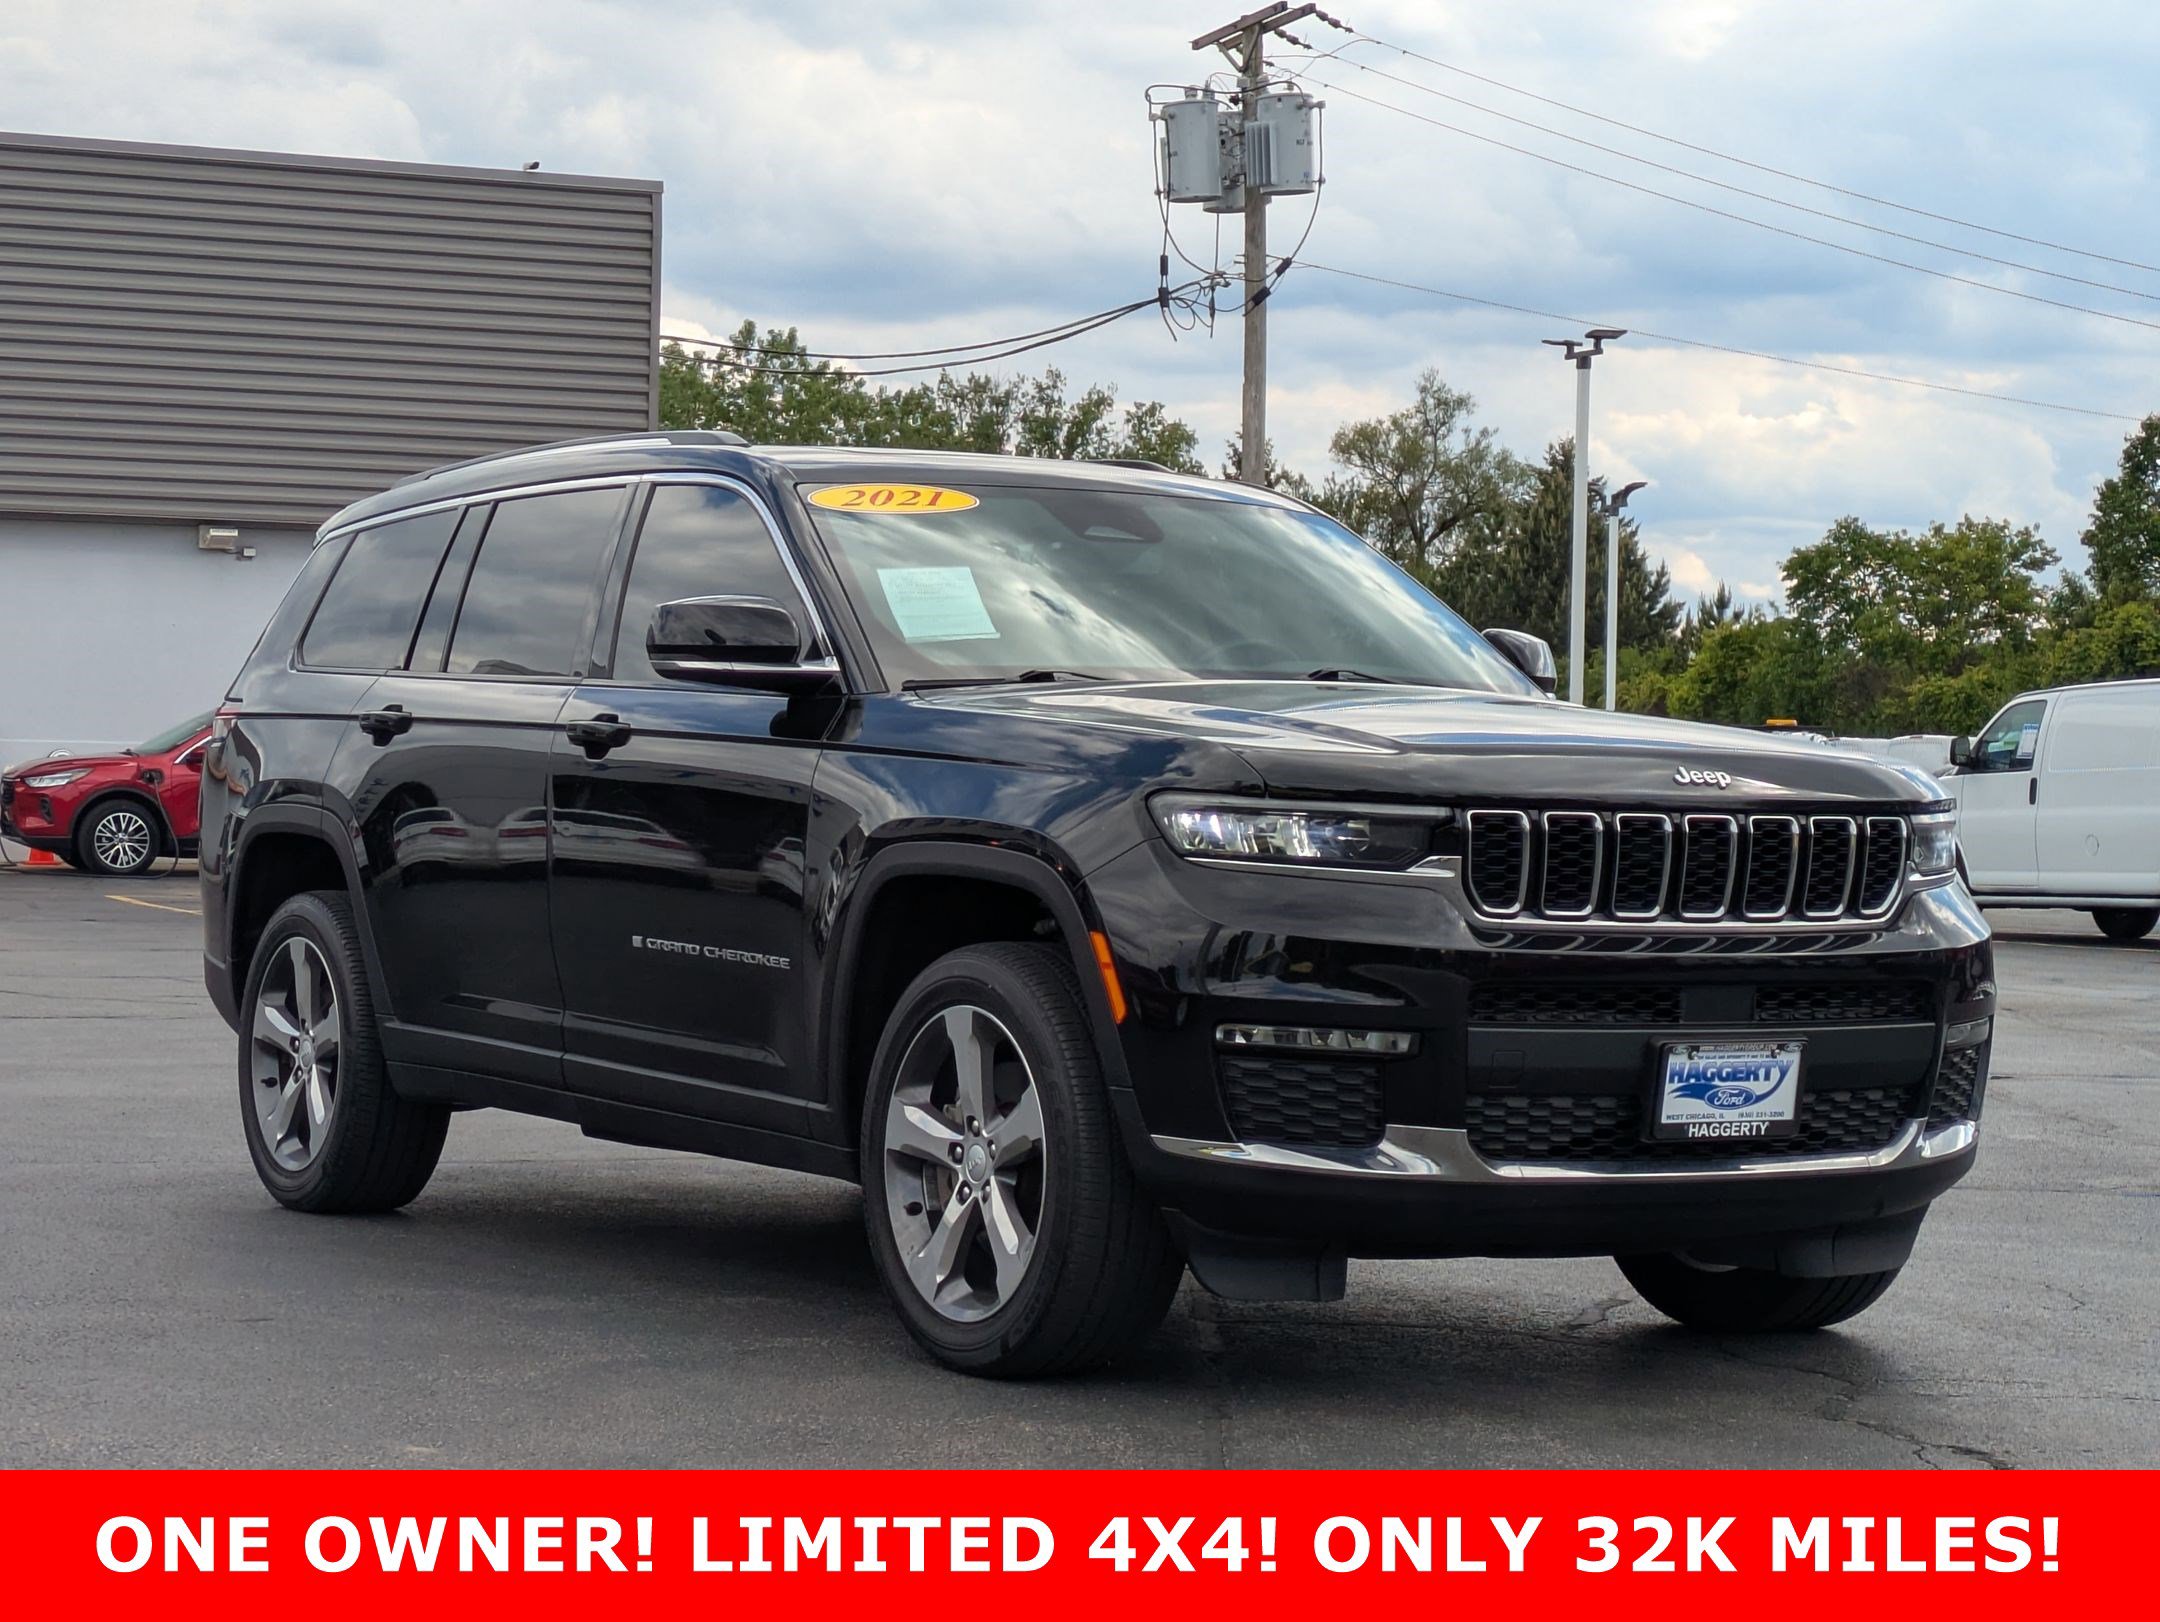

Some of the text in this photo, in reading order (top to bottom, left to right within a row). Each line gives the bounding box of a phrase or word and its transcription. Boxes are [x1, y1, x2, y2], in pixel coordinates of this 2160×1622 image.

[841, 489, 943, 508] 2021
[1674, 766, 1732, 789] Jeep
[646, 938, 791, 969] GRAND CHEROKEE
[1668, 1060, 1794, 1084] HAGGERTY
[1714, 1089, 1745, 1105] Ford
[1688, 1121, 1770, 1138] HAGGERTY
